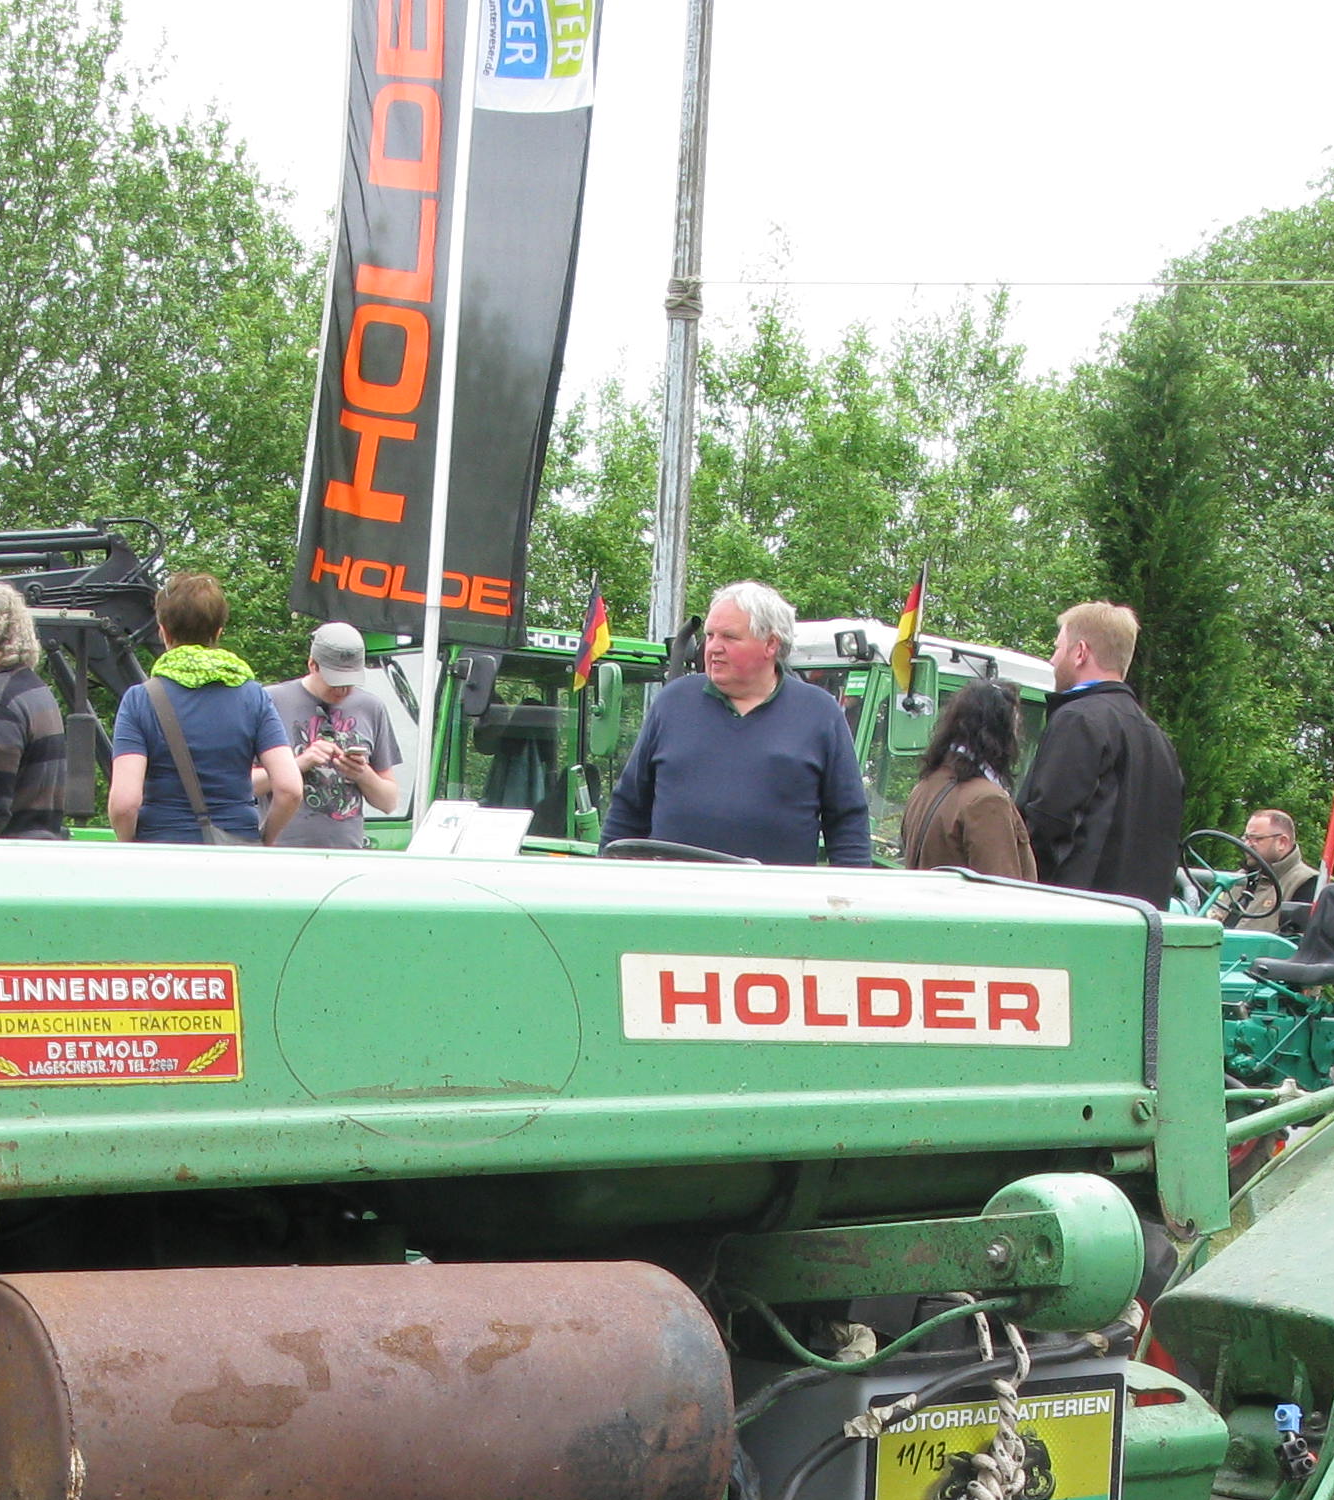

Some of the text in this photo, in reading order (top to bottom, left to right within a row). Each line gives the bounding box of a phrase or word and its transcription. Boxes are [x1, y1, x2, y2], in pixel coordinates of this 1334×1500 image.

[659, 970, 1041, 1032] HOLDER
[129, 1015, 222, 1031] TRAKTOREN
[47, 1039, 158, 1060] DETMOLD
[896, 1440, 947, 1476] 11/13
